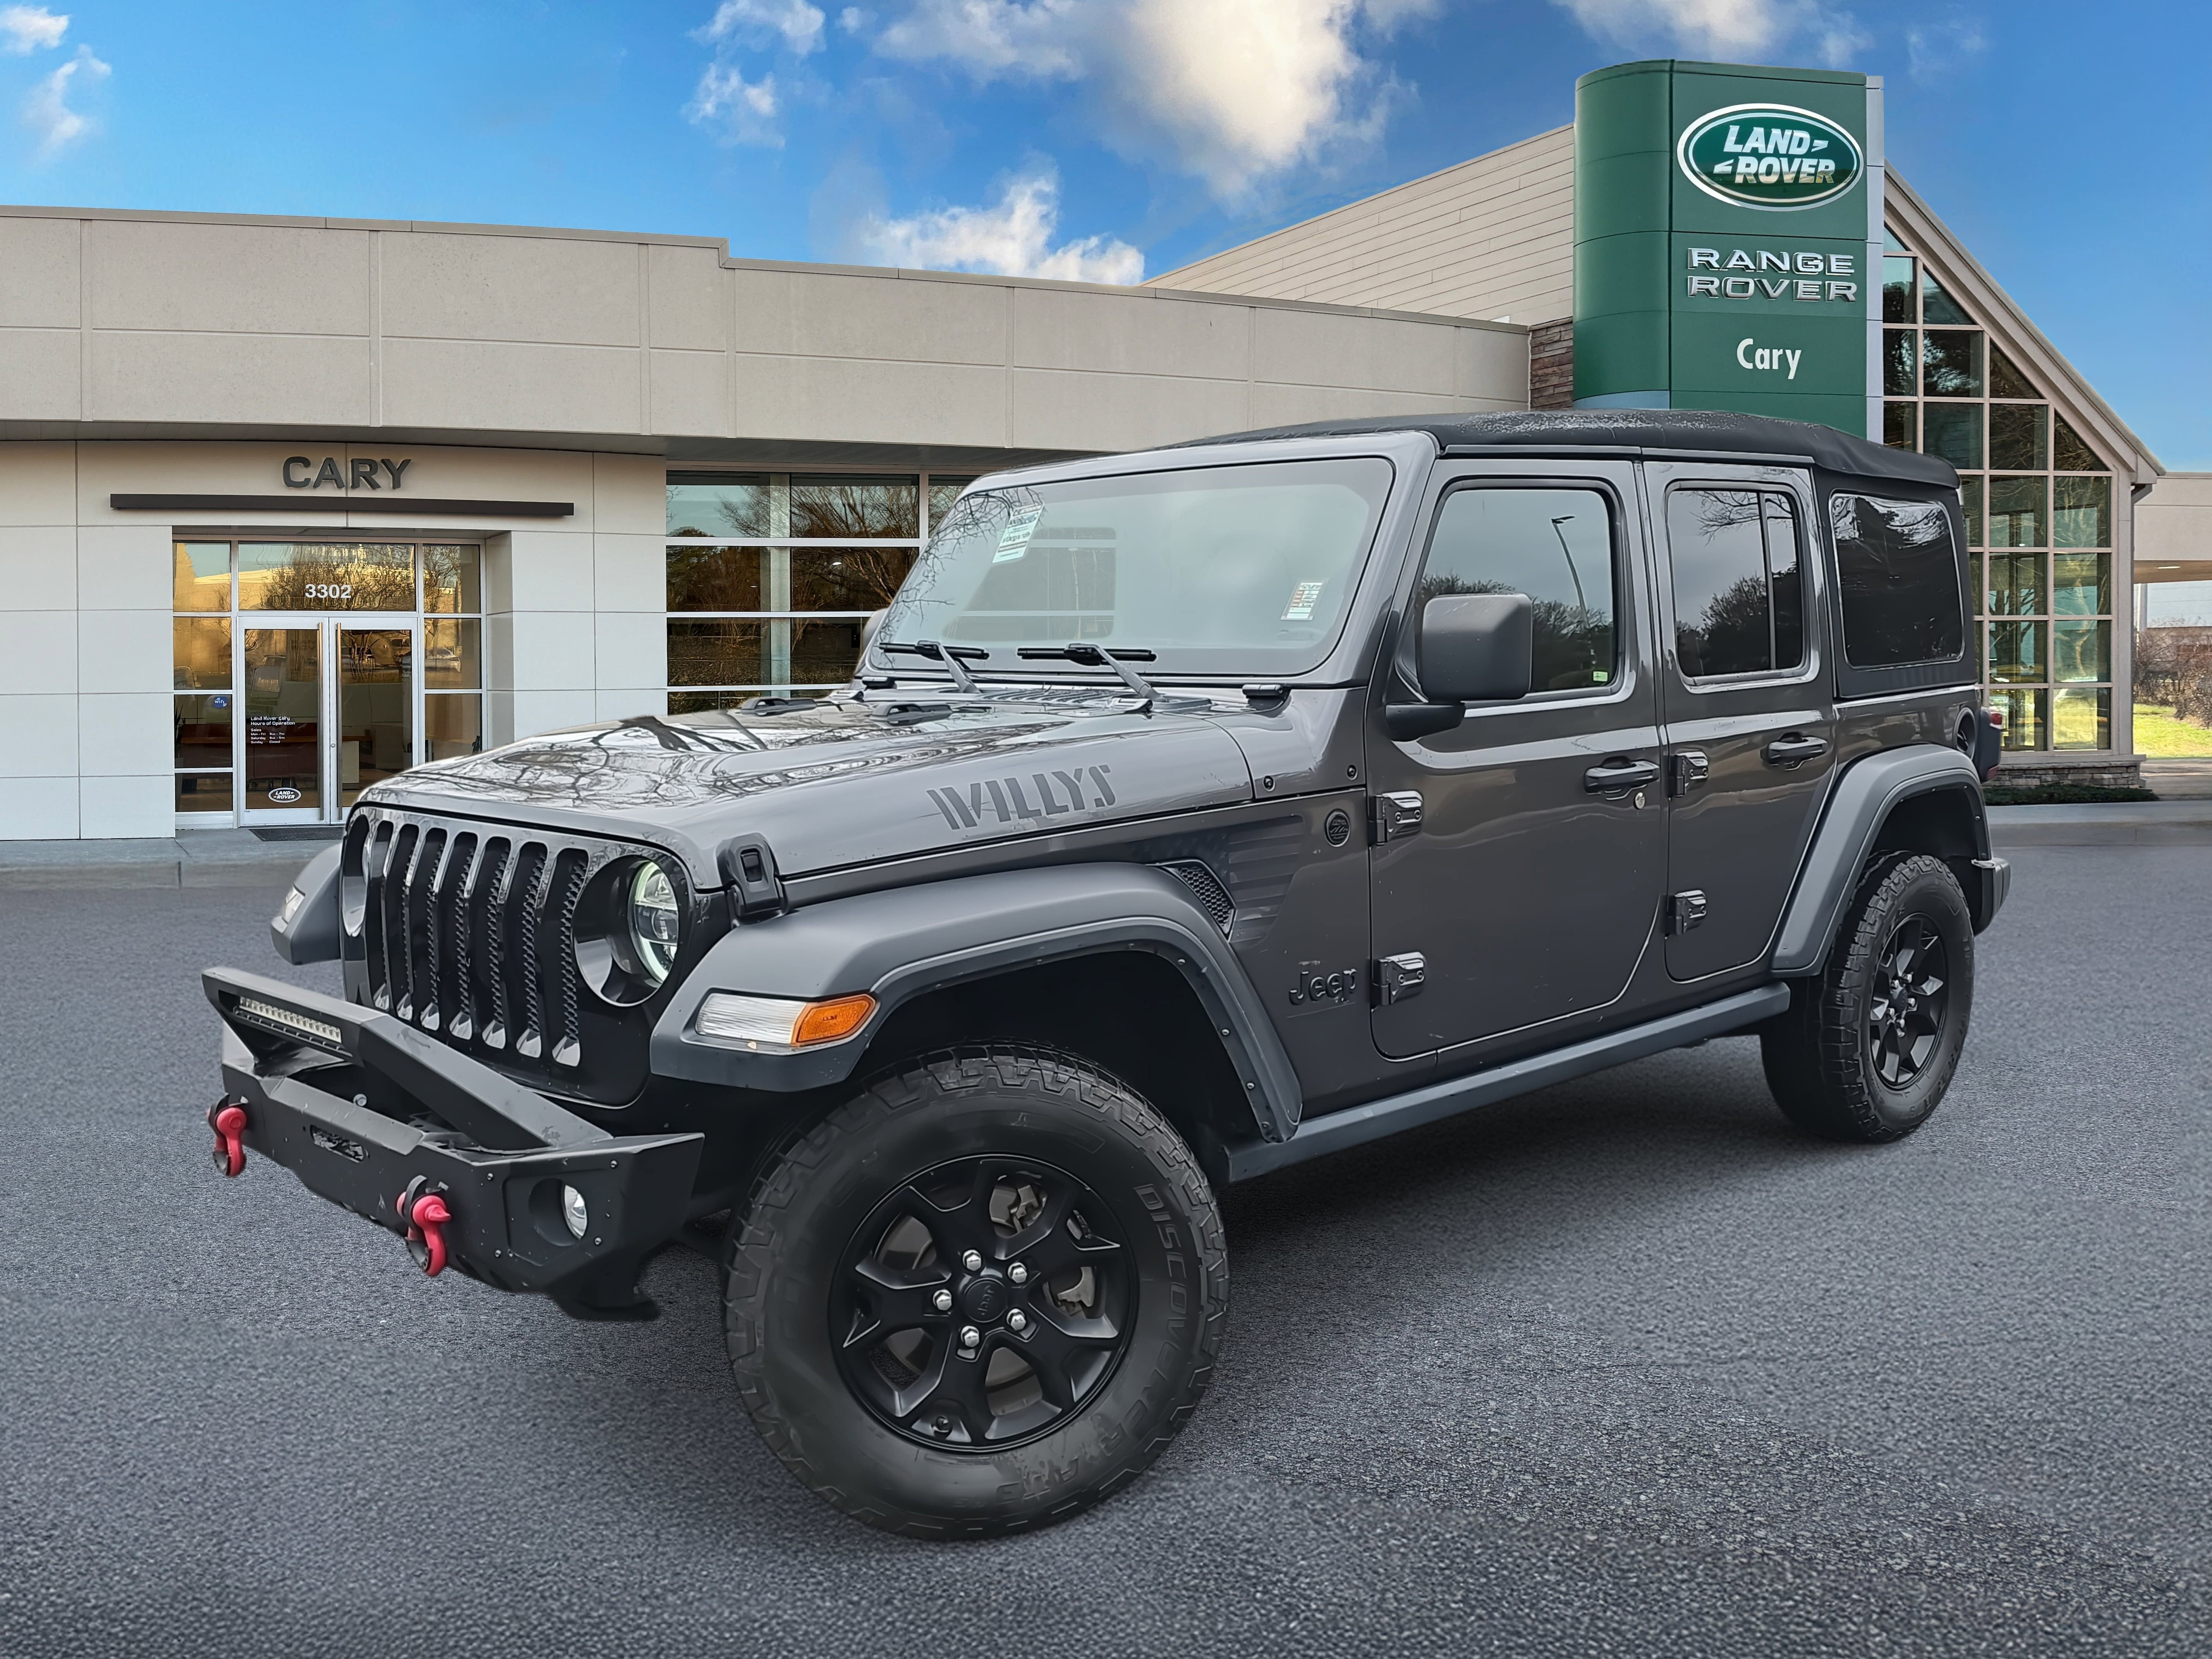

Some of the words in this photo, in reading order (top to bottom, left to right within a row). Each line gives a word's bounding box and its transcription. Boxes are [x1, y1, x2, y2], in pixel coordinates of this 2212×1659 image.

[1723, 125, 1811, 155] LAND
[1735, 156, 1835, 184] ROVER
[1688, 248, 1855, 275] RANGE
[1688, 276, 1857, 303] ROVER
[1737, 338, 1802, 380] Cary
[283, 456, 412, 489] CARY
[305, 584, 352, 599] 3302
[926, 764, 1116, 830] WILLYS
[1289, 967, 1357, 1006] Jeep
